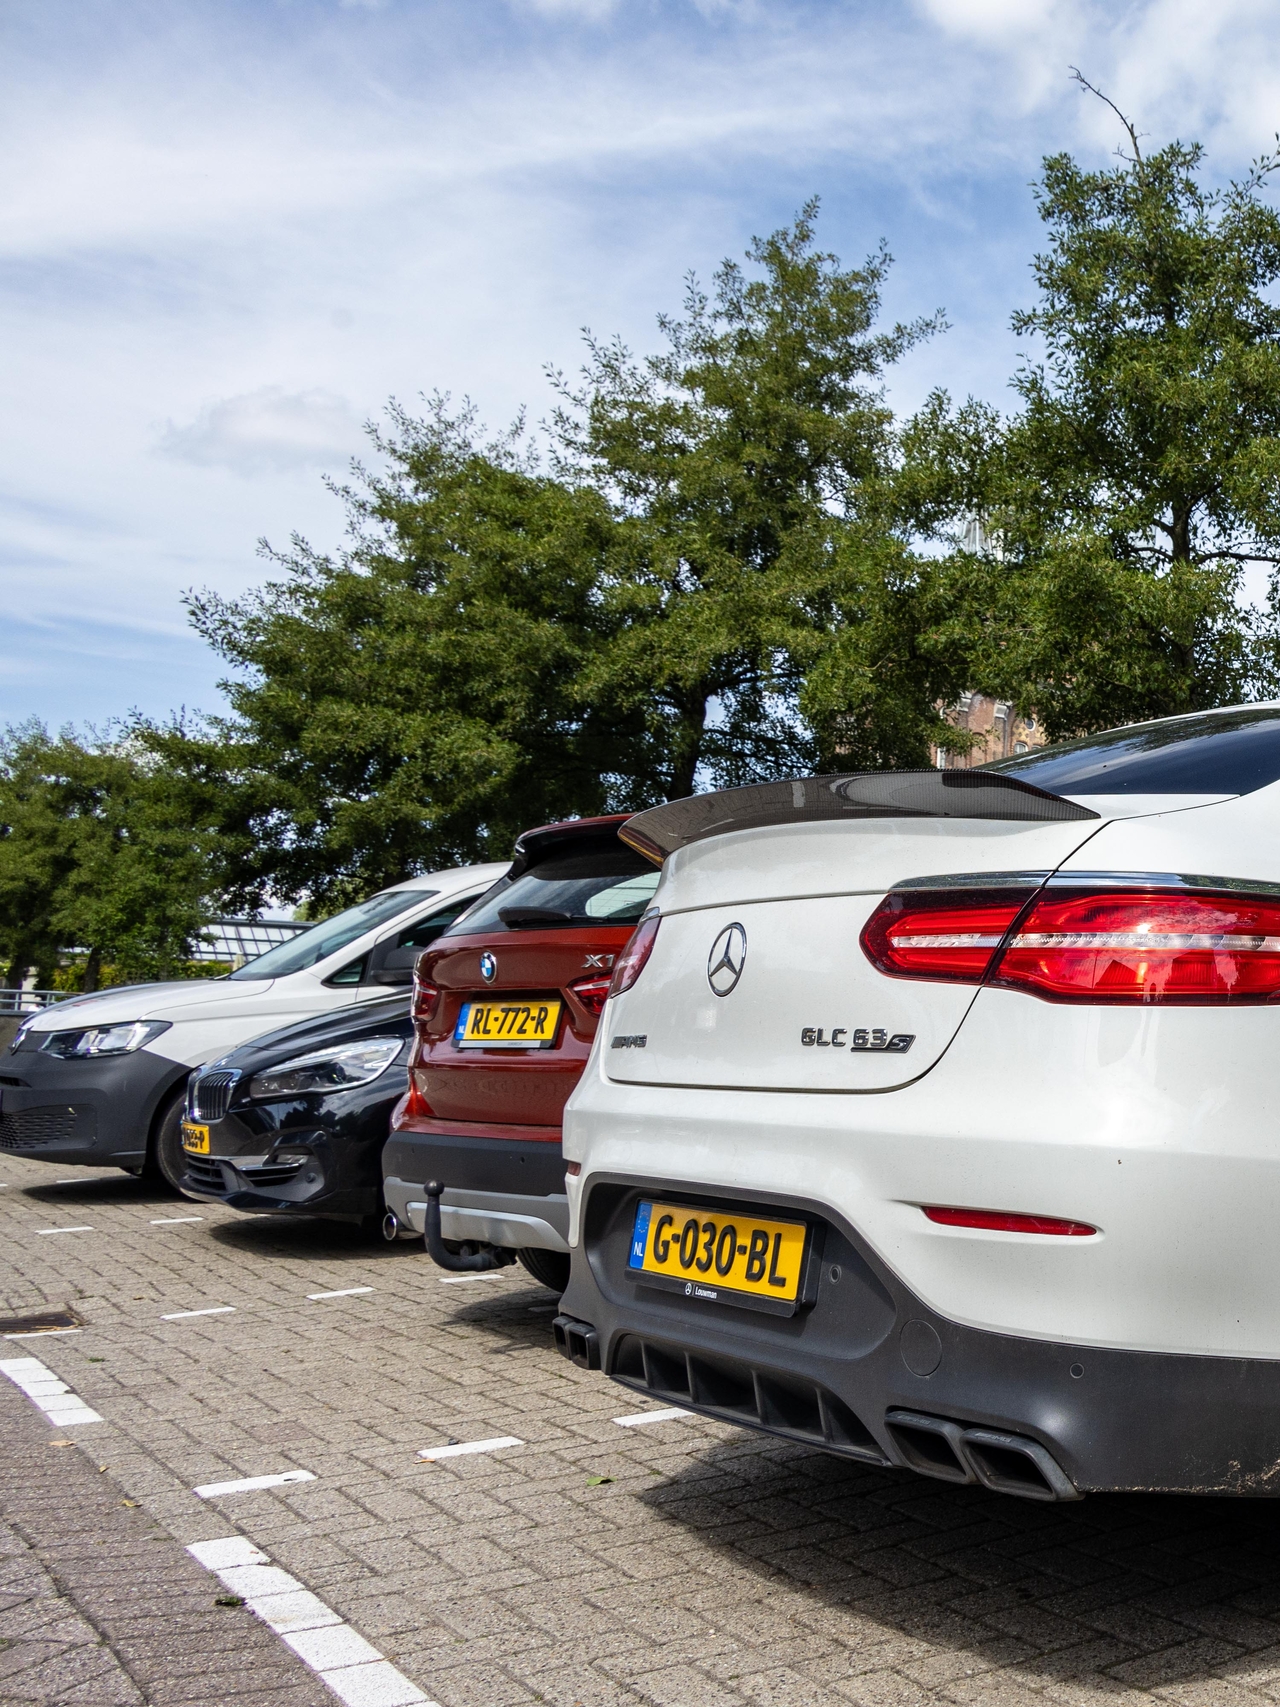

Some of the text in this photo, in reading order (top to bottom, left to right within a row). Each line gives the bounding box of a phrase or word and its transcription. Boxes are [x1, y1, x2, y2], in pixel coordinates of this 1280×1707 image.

[581, 954, 616, 968] X1
[471, 1006, 549, 1035] RL-772-R
[801, 1027, 847, 1047] GLC
[633, 1241, 643, 1257] NL
[653, 1214, 787, 1288] G-030-BL
[695, 1285, 718, 1300] Louwman
